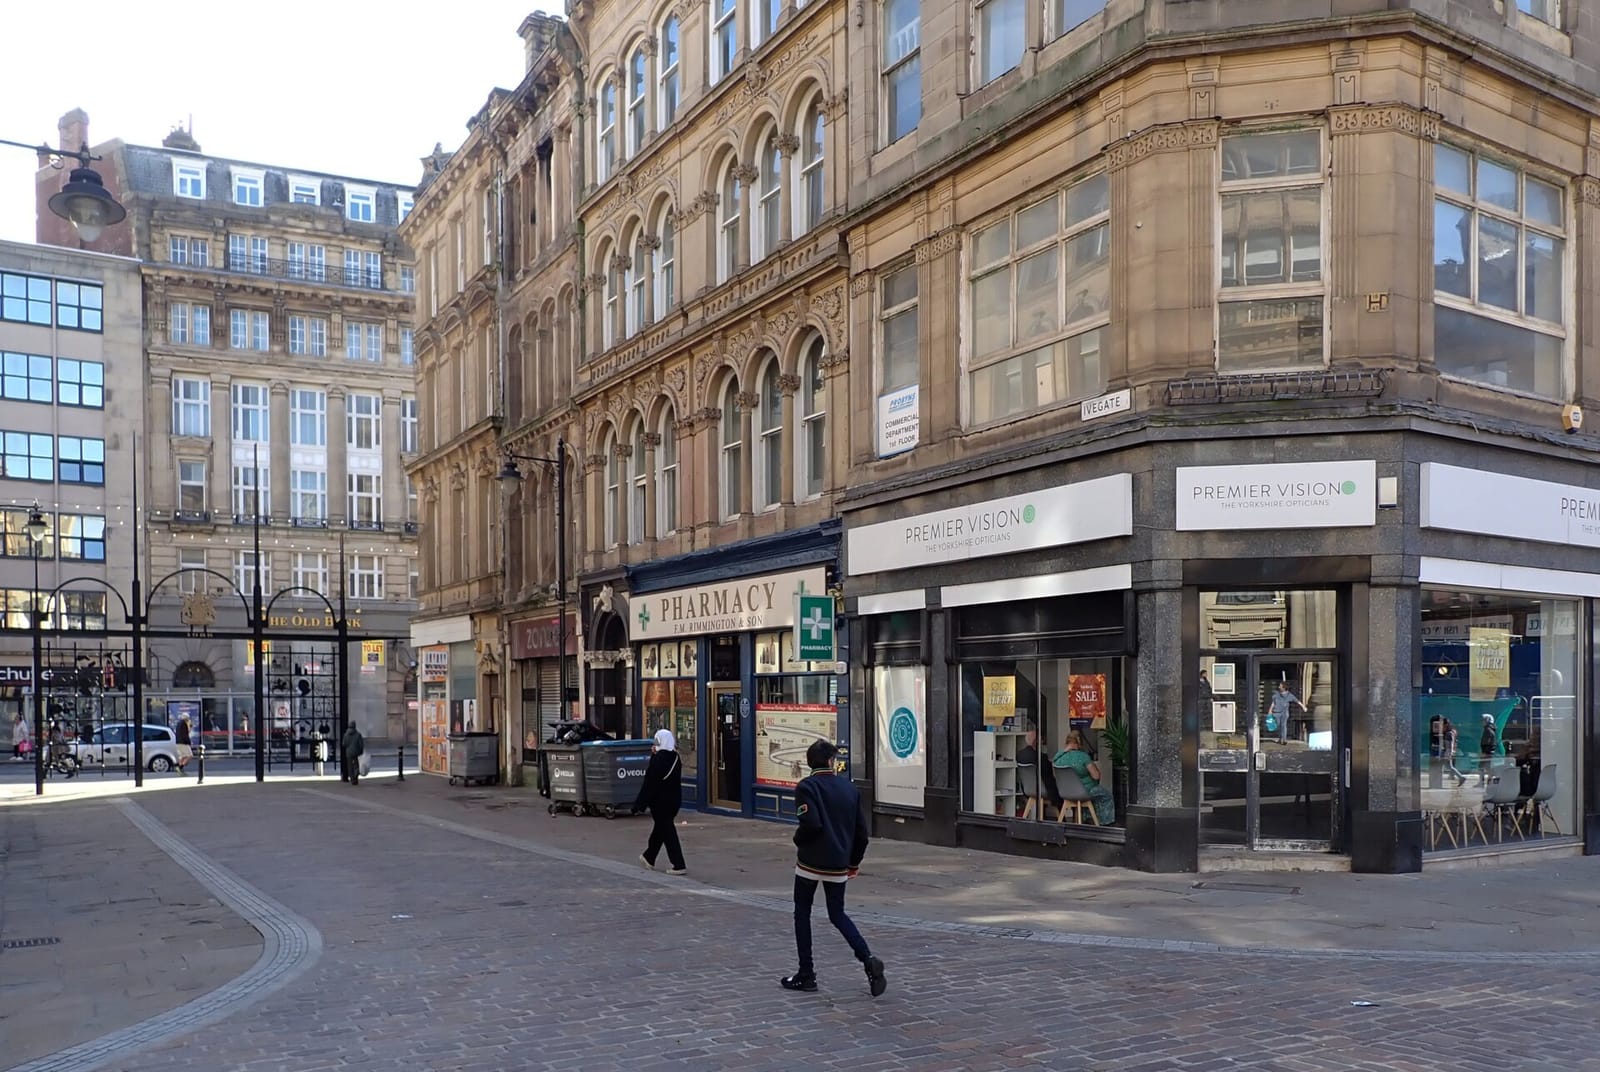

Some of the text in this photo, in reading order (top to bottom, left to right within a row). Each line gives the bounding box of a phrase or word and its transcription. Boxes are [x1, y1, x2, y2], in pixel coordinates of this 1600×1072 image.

[1083, 396, 1121, 417] IVEGATE
[885, 412, 920, 429] COMMERCIAL
[885, 423, 919, 438] DEPARTMENT
[898, 434, 916, 445] FLOOR
[1193, 482, 1341, 500] PREMIER VISION
[1238, 500, 1283, 509] YORKSHIRE
[1285, 499, 1329, 507] OPTICIANS
[905, 507, 1020, 544] PREMIER VISION
[925, 532, 1011, 553] THE YORKSHIRE OPTICIANS
[661, 582, 776, 622] PHARMACY
[325, 616, 361, 627] BNK
[689, 618, 736, 633] RIMMINGTON
[739, 617, 744, 627] &
[747, 615, 763, 627] SON
[363, 644, 383, 652] TO LET
[1075, 691, 1098, 702] SALE
[626, 769, 646, 777] VEOLI
